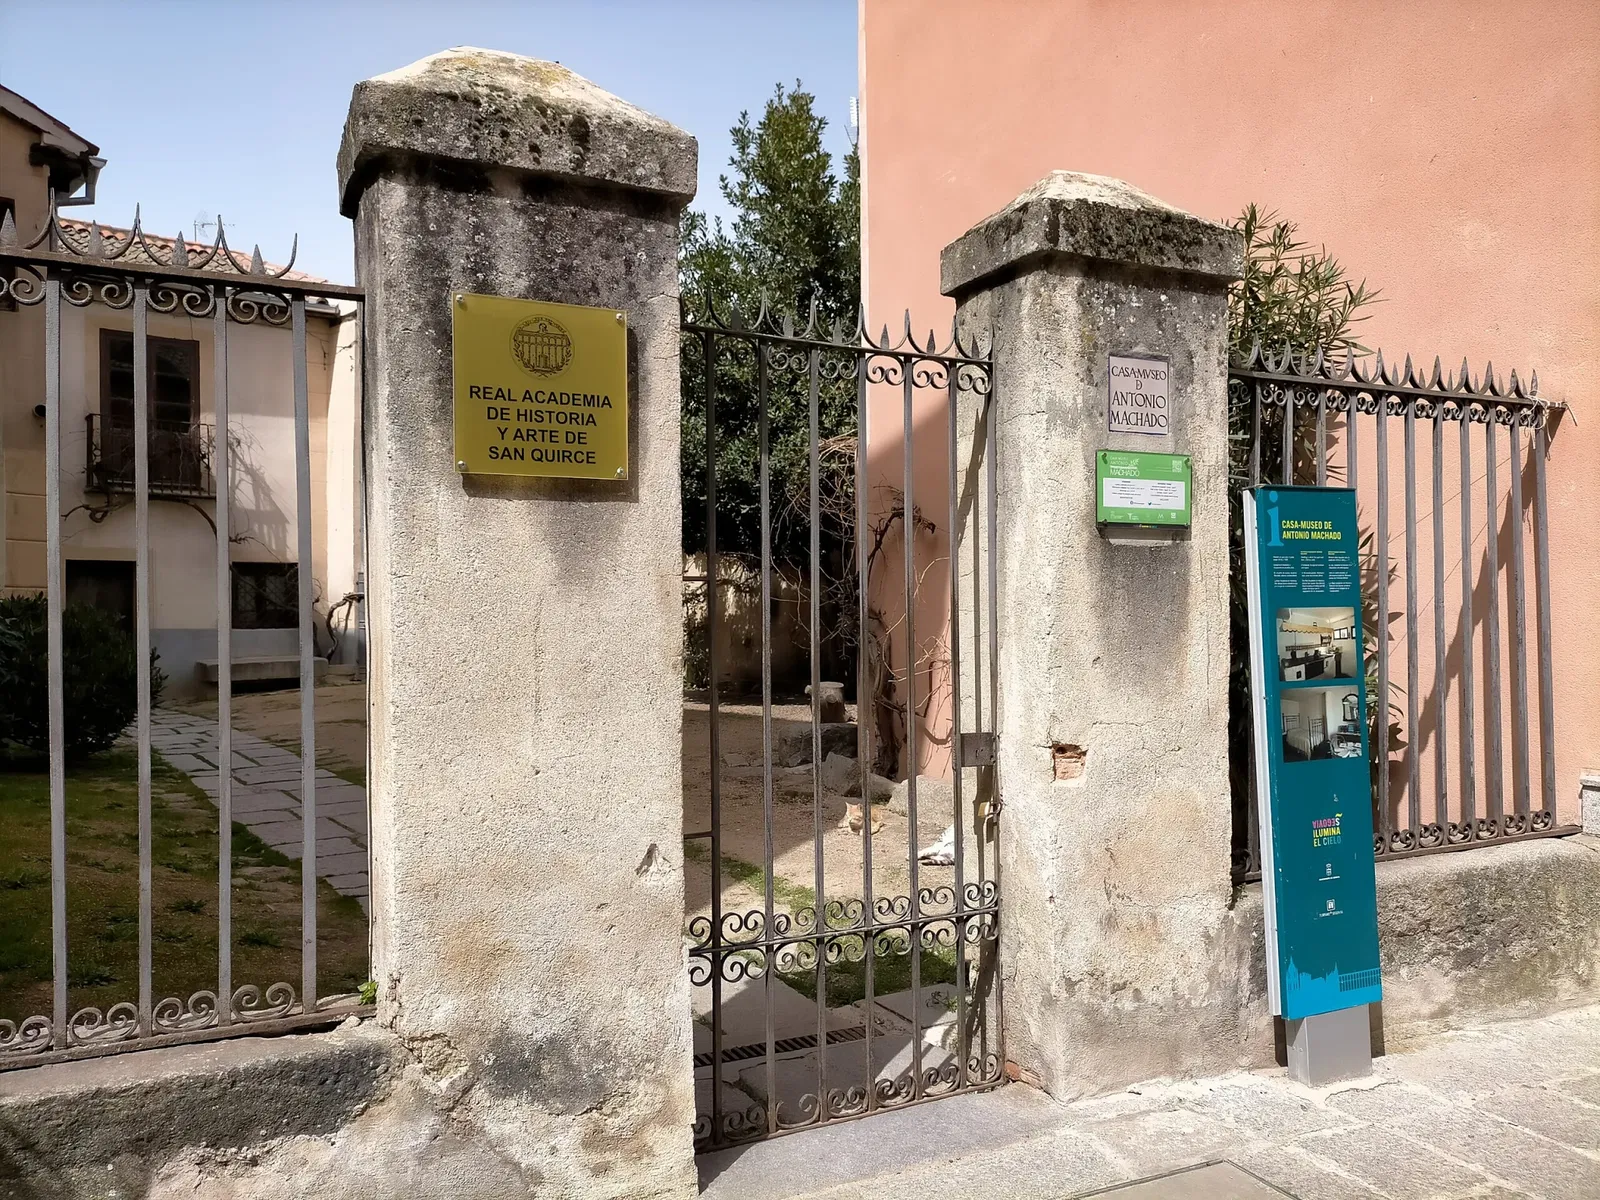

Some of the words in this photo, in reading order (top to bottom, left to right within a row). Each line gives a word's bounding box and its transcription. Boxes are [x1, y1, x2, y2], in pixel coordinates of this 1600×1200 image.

[469, 385, 517, 402] REAL
[522, 389, 612, 409] ACADEMIA
[1112, 390, 1166, 409] ANTONIO
[487, 406, 511, 421] DE
[516, 408, 597, 426] HISTORIA
[1110, 410, 1168, 428] MACHADO
[497, 426, 508, 441] Y
[513, 428, 559, 443] ARTE
[565, 431, 588, 445] DE
[488, 446, 525, 461] SAN
[531, 448, 596, 464] QUIRCE
[1109, 468, 1140, 477] MACHADO
[1281, 520, 1323, 530] CASA-MUSEO
[1324, 521, 1333, 530] DE
[1282, 531, 1310, 540] ANTONIO
[1311, 531, 1342, 540] MACHADO
[1312, 826, 1341, 838] ILUMINA
[1313, 838, 1322, 847] EL
[1322, 835, 1342, 846] CIELO
